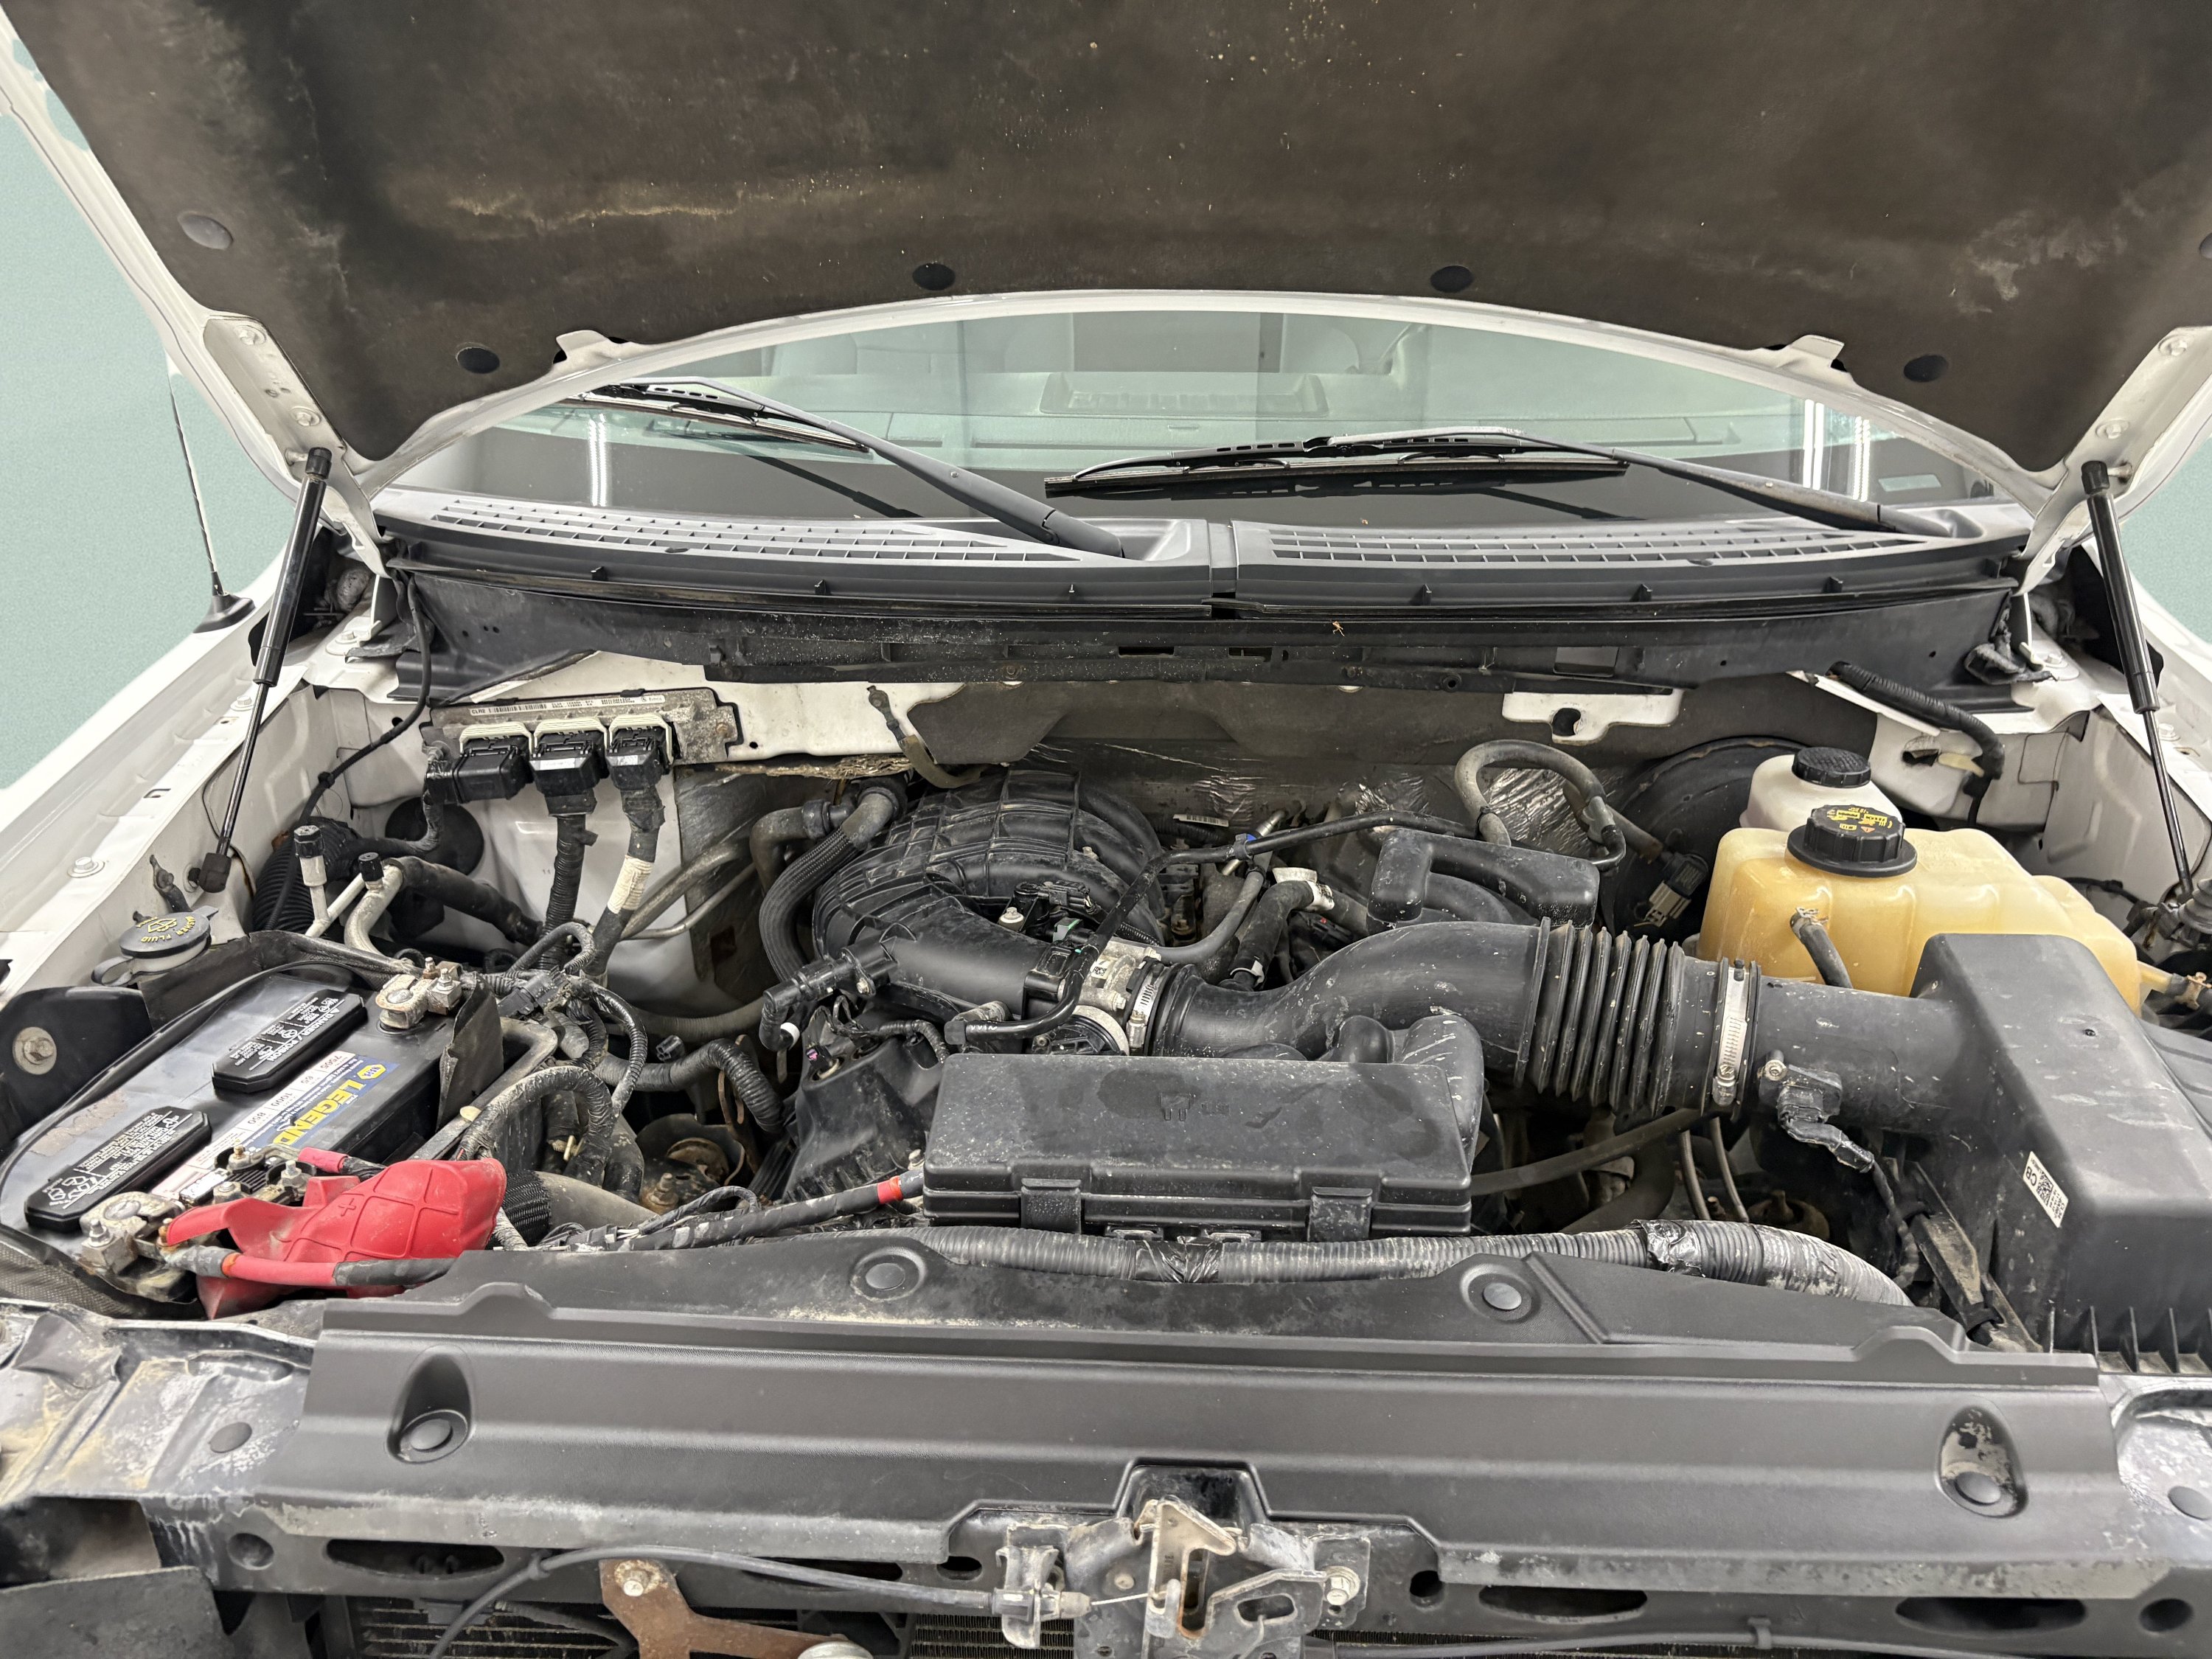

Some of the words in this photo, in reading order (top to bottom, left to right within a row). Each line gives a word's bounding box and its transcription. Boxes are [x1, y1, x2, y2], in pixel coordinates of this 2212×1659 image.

[141, 933, 172, 942] FLUID
[302, 1014, 334, 1035] DANGER
[266, 1040, 299, 1061] POISON
[320, 1055, 342, 1068] 7565
[362, 1065, 381, 1077] NAPA
[248, 1112, 265, 1124] 850
[273, 1079, 366, 1146] LEGEND
[2025, 1166, 2037, 1186] CB
